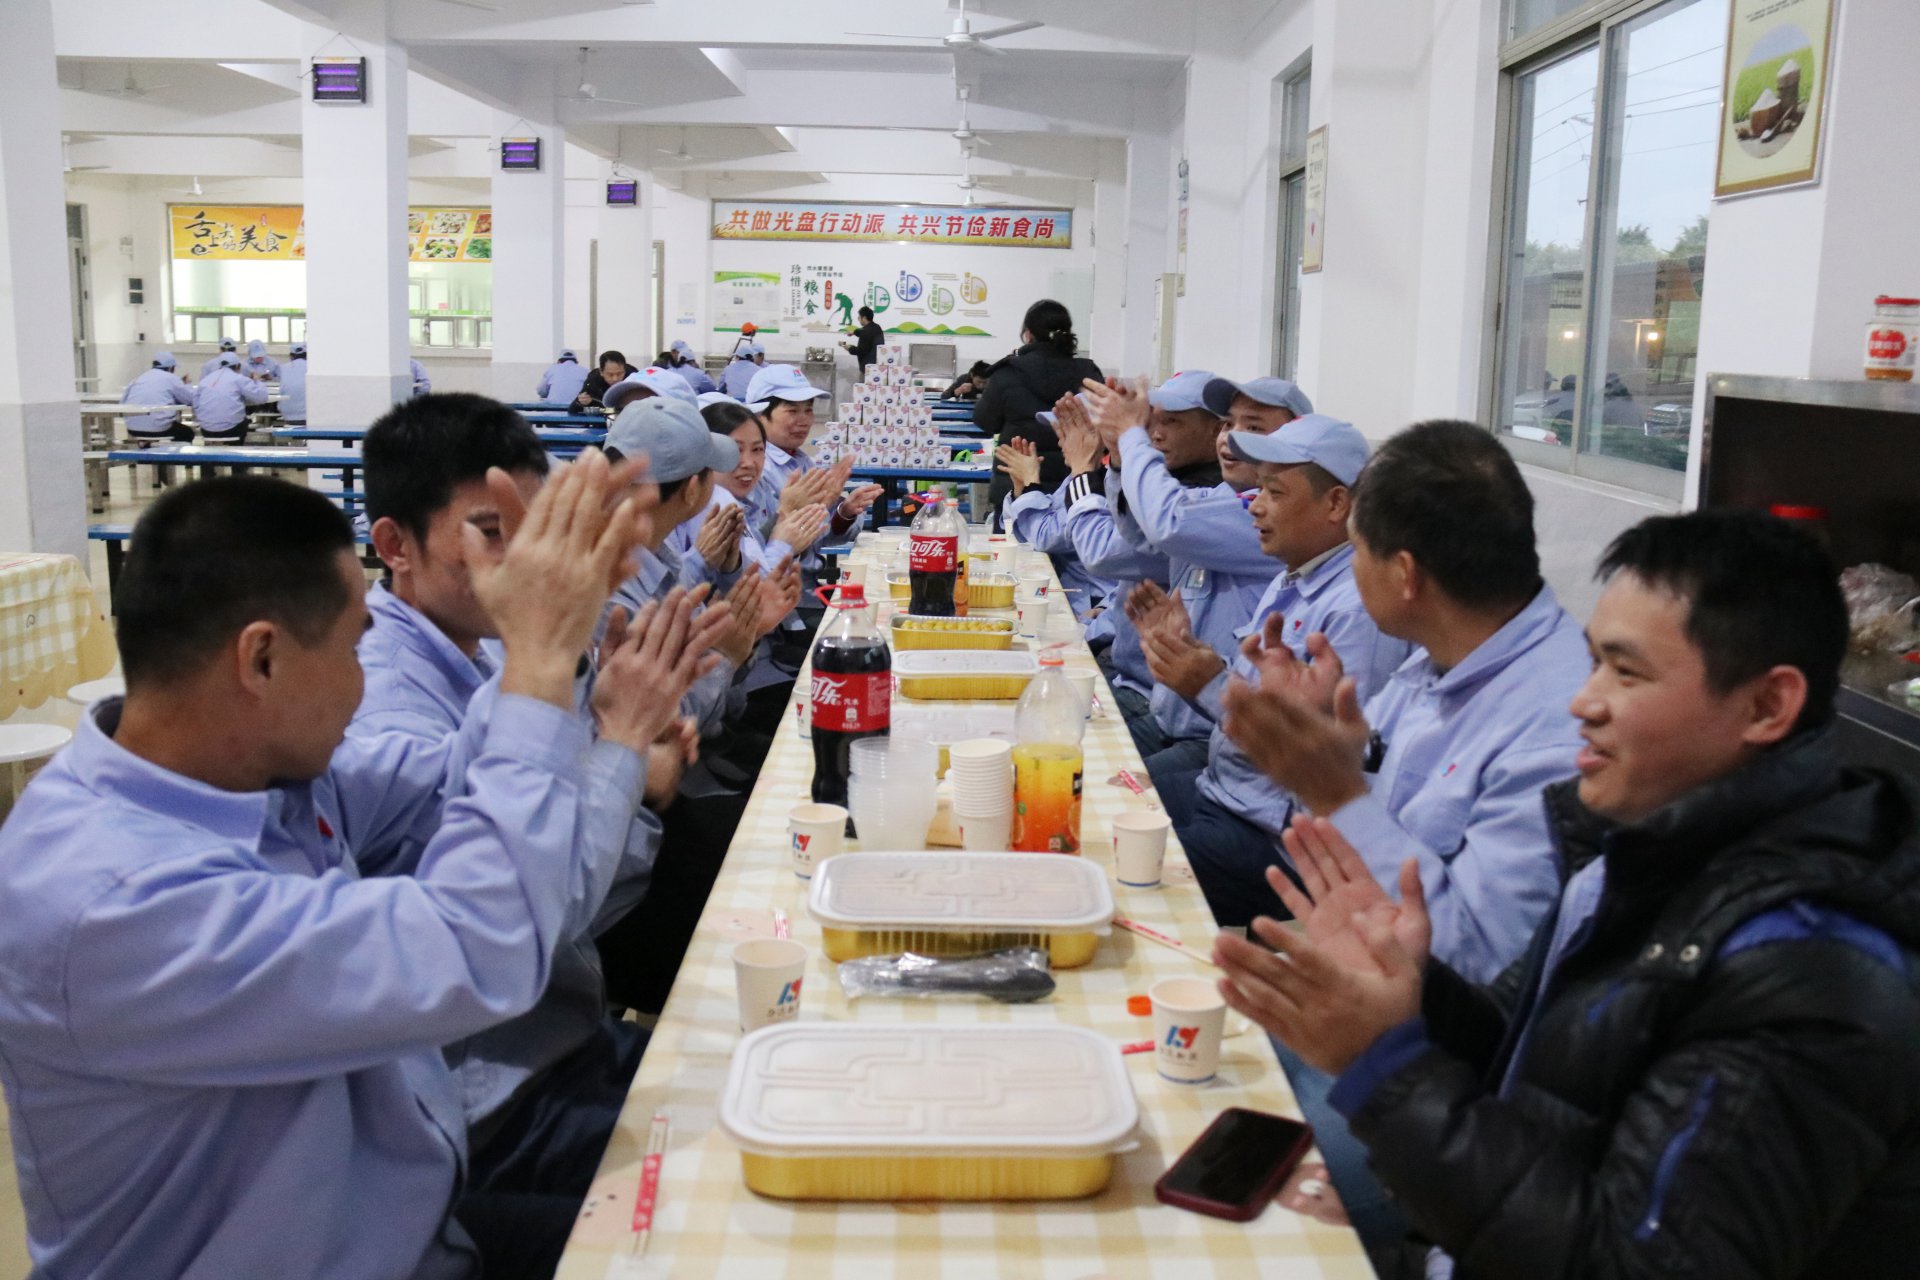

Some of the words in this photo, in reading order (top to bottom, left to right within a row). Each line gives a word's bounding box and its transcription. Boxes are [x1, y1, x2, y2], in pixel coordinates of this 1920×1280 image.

[729, 209, 885, 234] 共做光盘行动派
[897, 214, 1055, 238] 共兴节俭新食尚
[803, 279, 819, 315] 粮食
